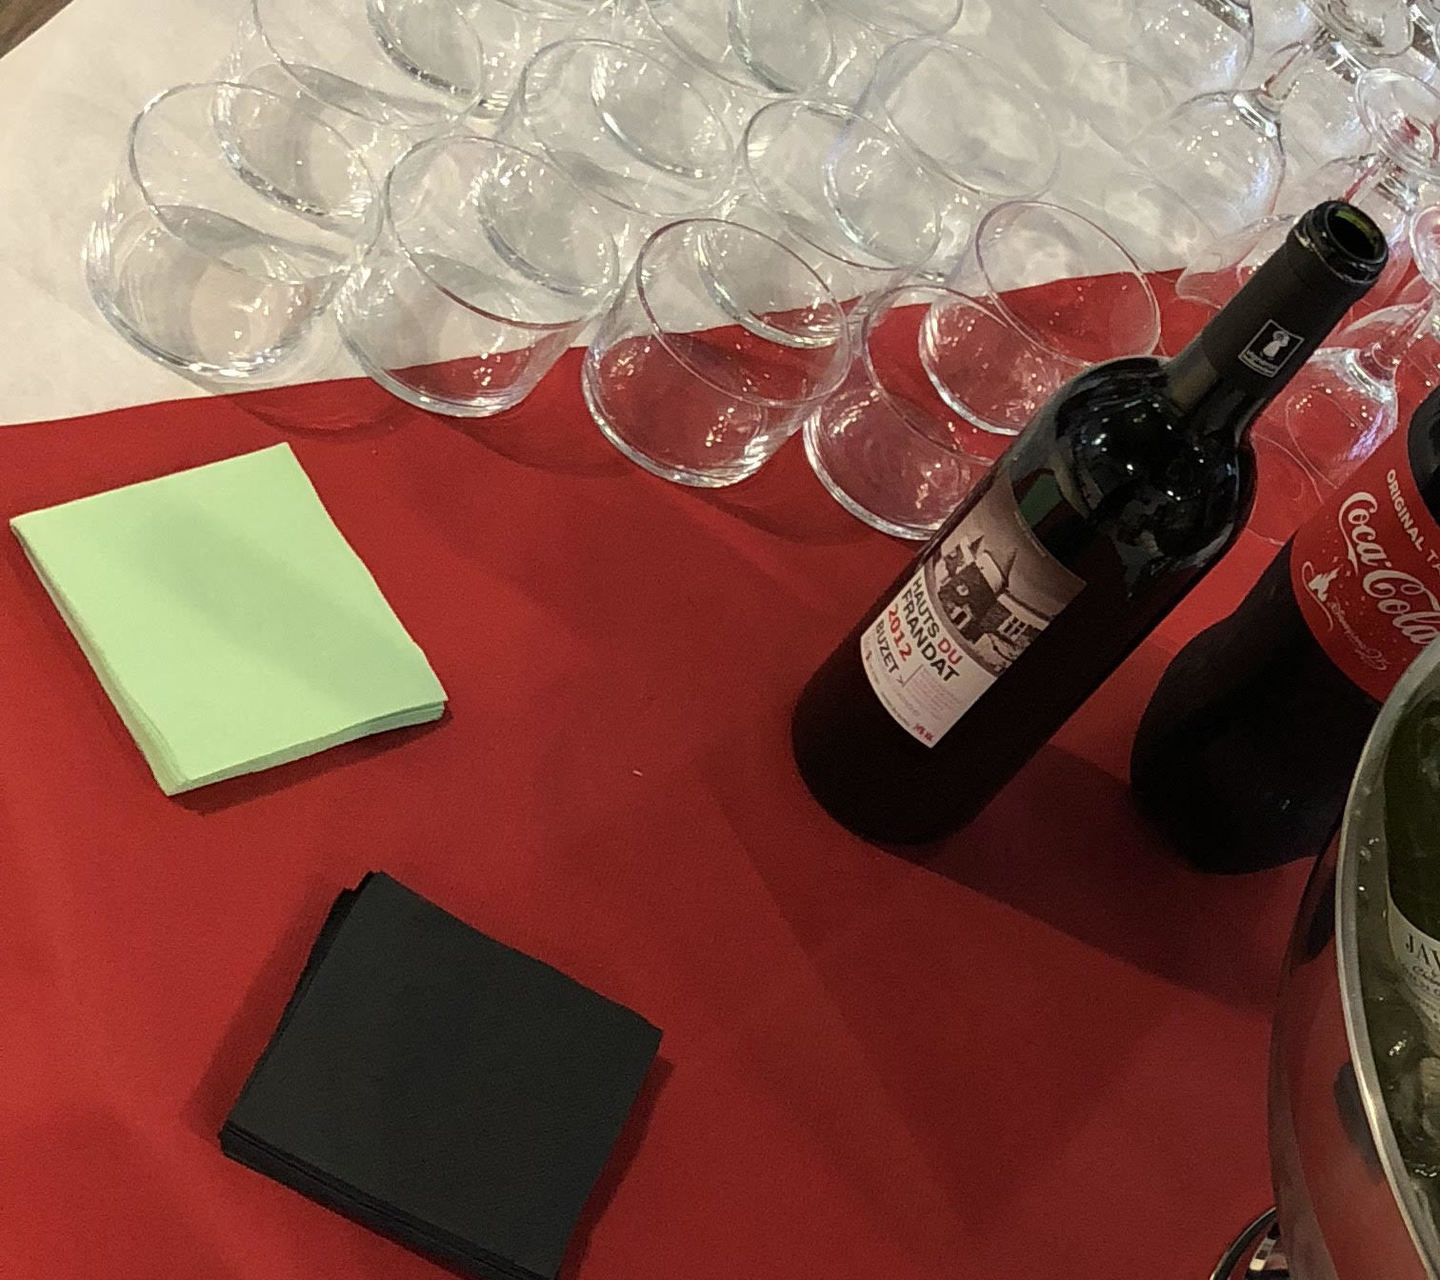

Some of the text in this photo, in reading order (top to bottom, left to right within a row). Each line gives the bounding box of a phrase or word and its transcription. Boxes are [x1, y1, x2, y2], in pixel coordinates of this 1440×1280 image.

[1386, 468, 1424, 551] ORIGINAL
[874, 619, 899, 675] BUZET
[887, 605, 912, 662] 2012
[902, 589, 960, 682] FRANDAT
[911, 575, 941, 639] HAUTS
[937, 638, 963, 665] DU
